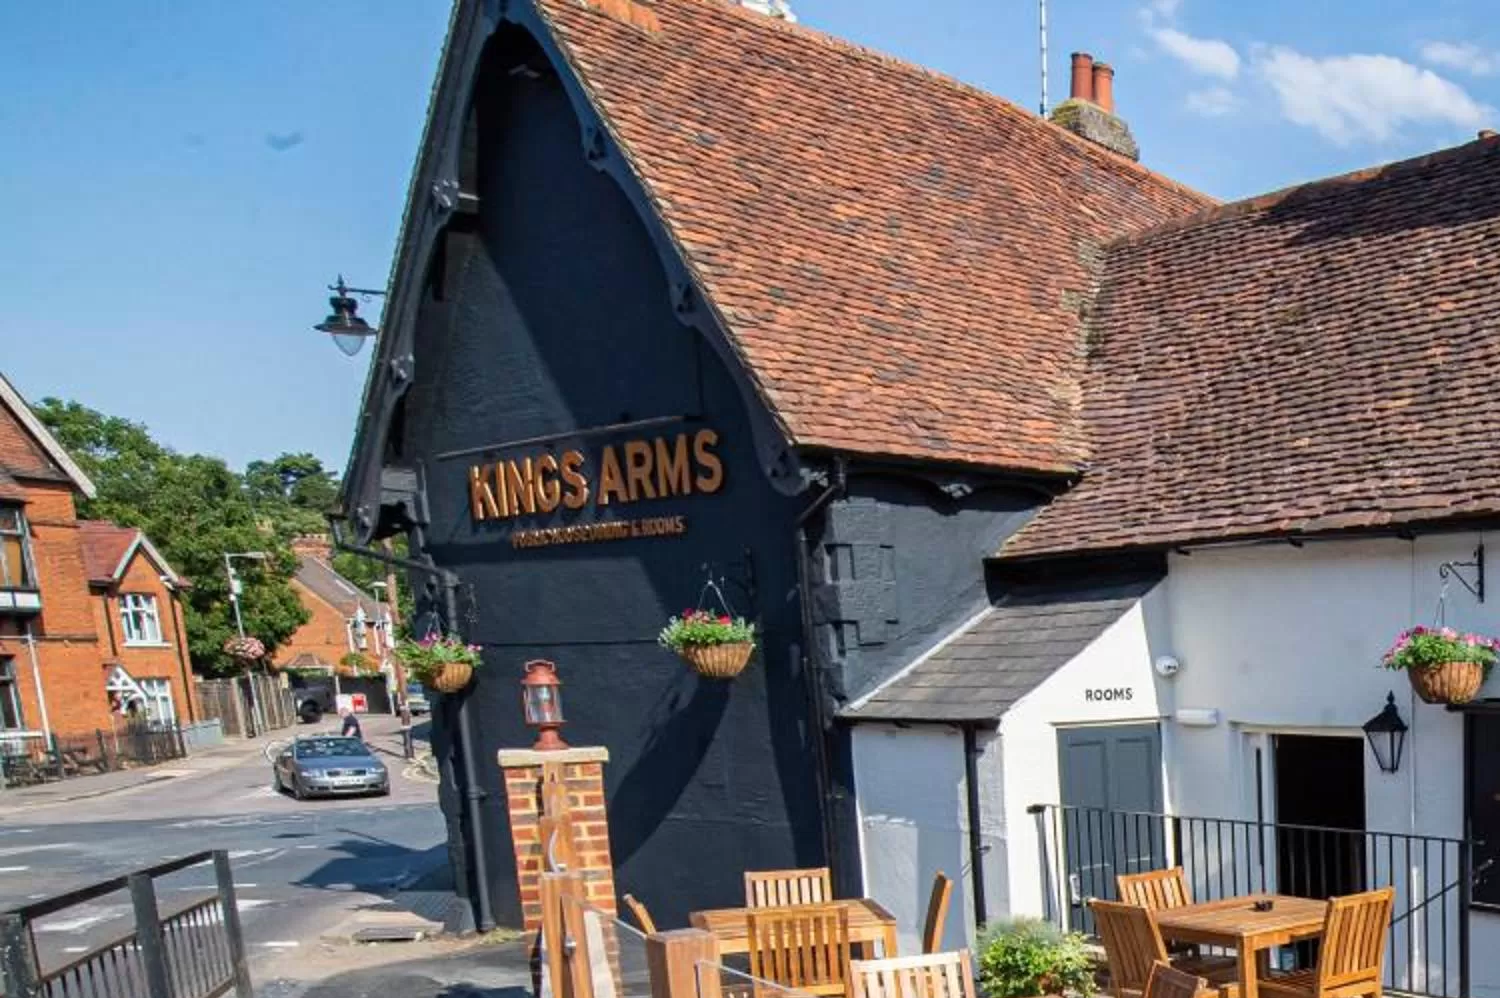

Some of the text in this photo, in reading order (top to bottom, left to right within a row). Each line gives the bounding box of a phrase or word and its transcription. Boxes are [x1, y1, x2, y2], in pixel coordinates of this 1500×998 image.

[469, 428, 724, 520] KINGS ARMS
[1085, 688, 1133, 701] ROOMS
